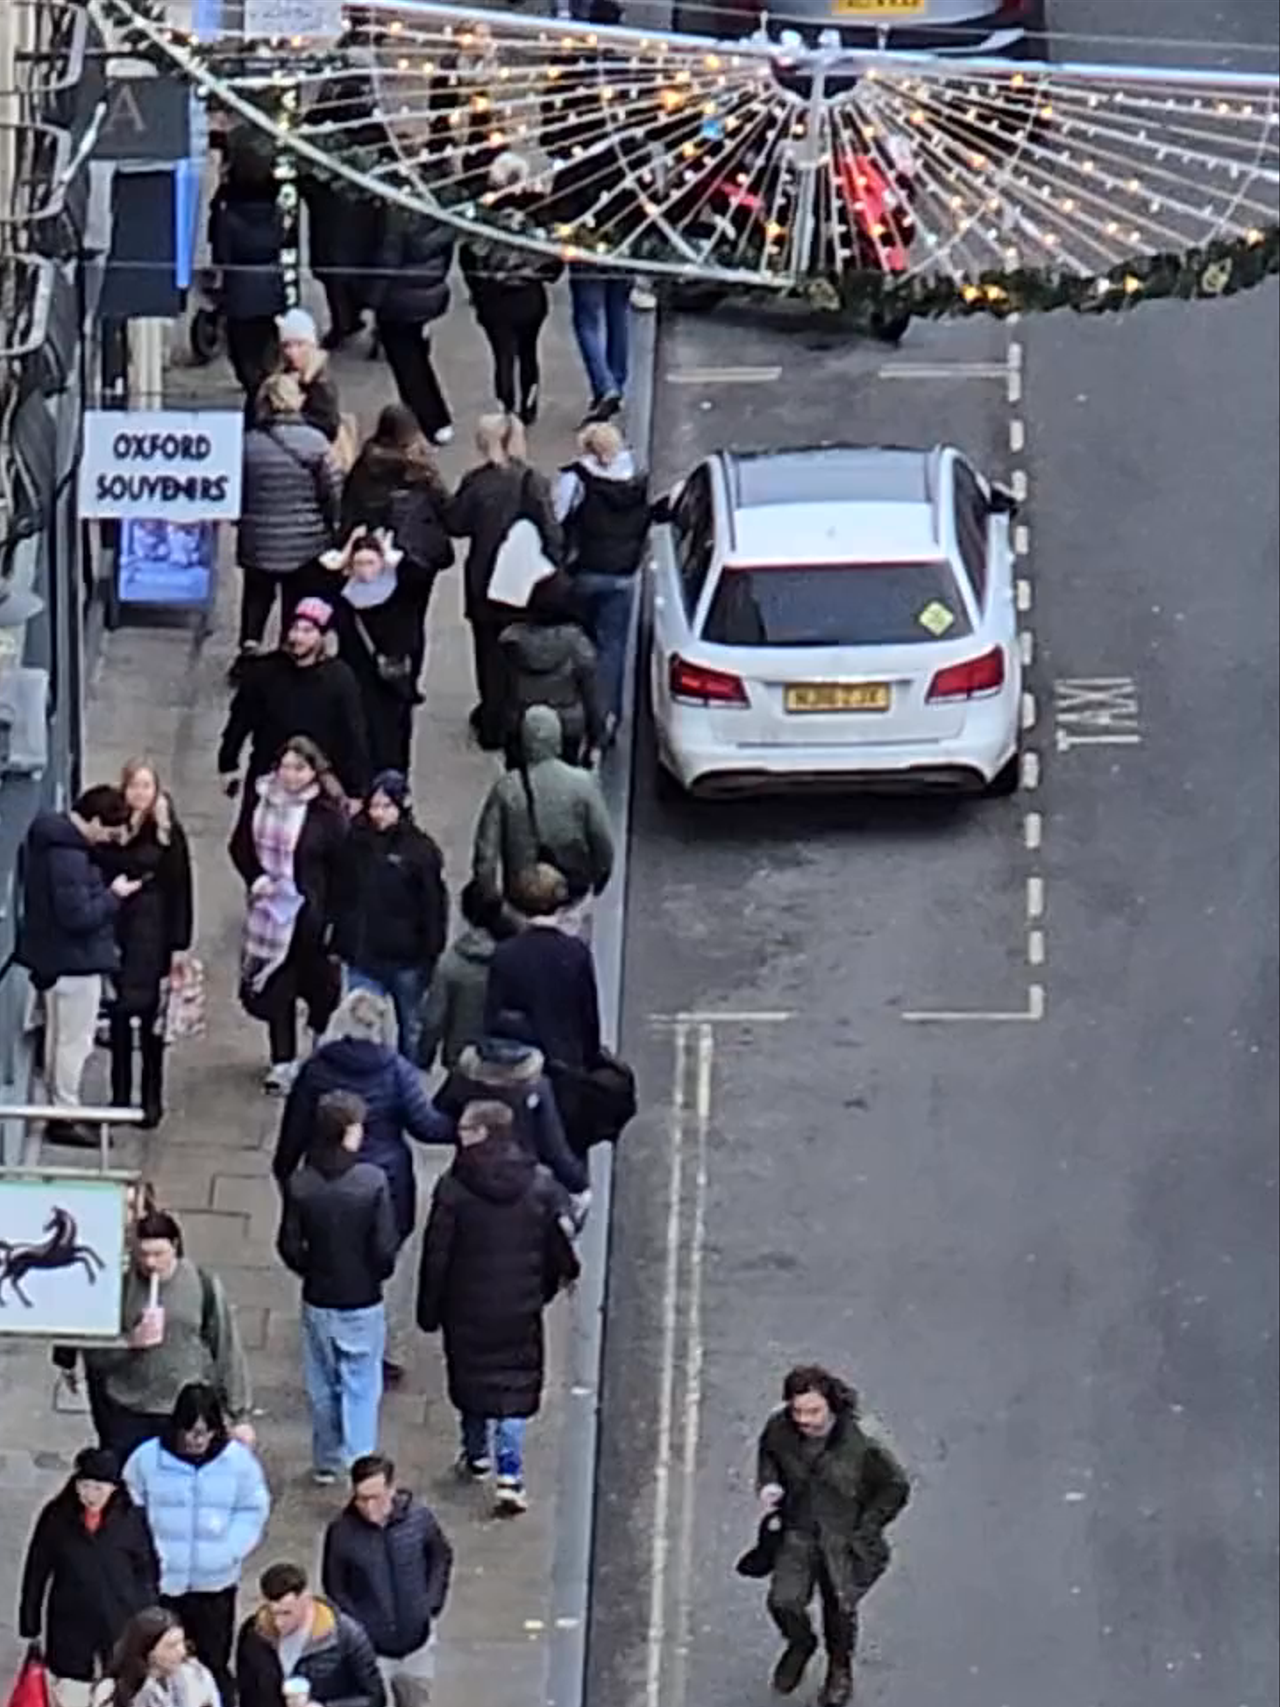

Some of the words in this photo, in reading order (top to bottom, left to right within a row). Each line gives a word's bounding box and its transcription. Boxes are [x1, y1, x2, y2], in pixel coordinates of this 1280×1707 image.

[113, 432, 211, 461] OXFORD
[96, 474, 229, 501] SOUVENIRS
[1054, 677, 1140, 751] TAXI
